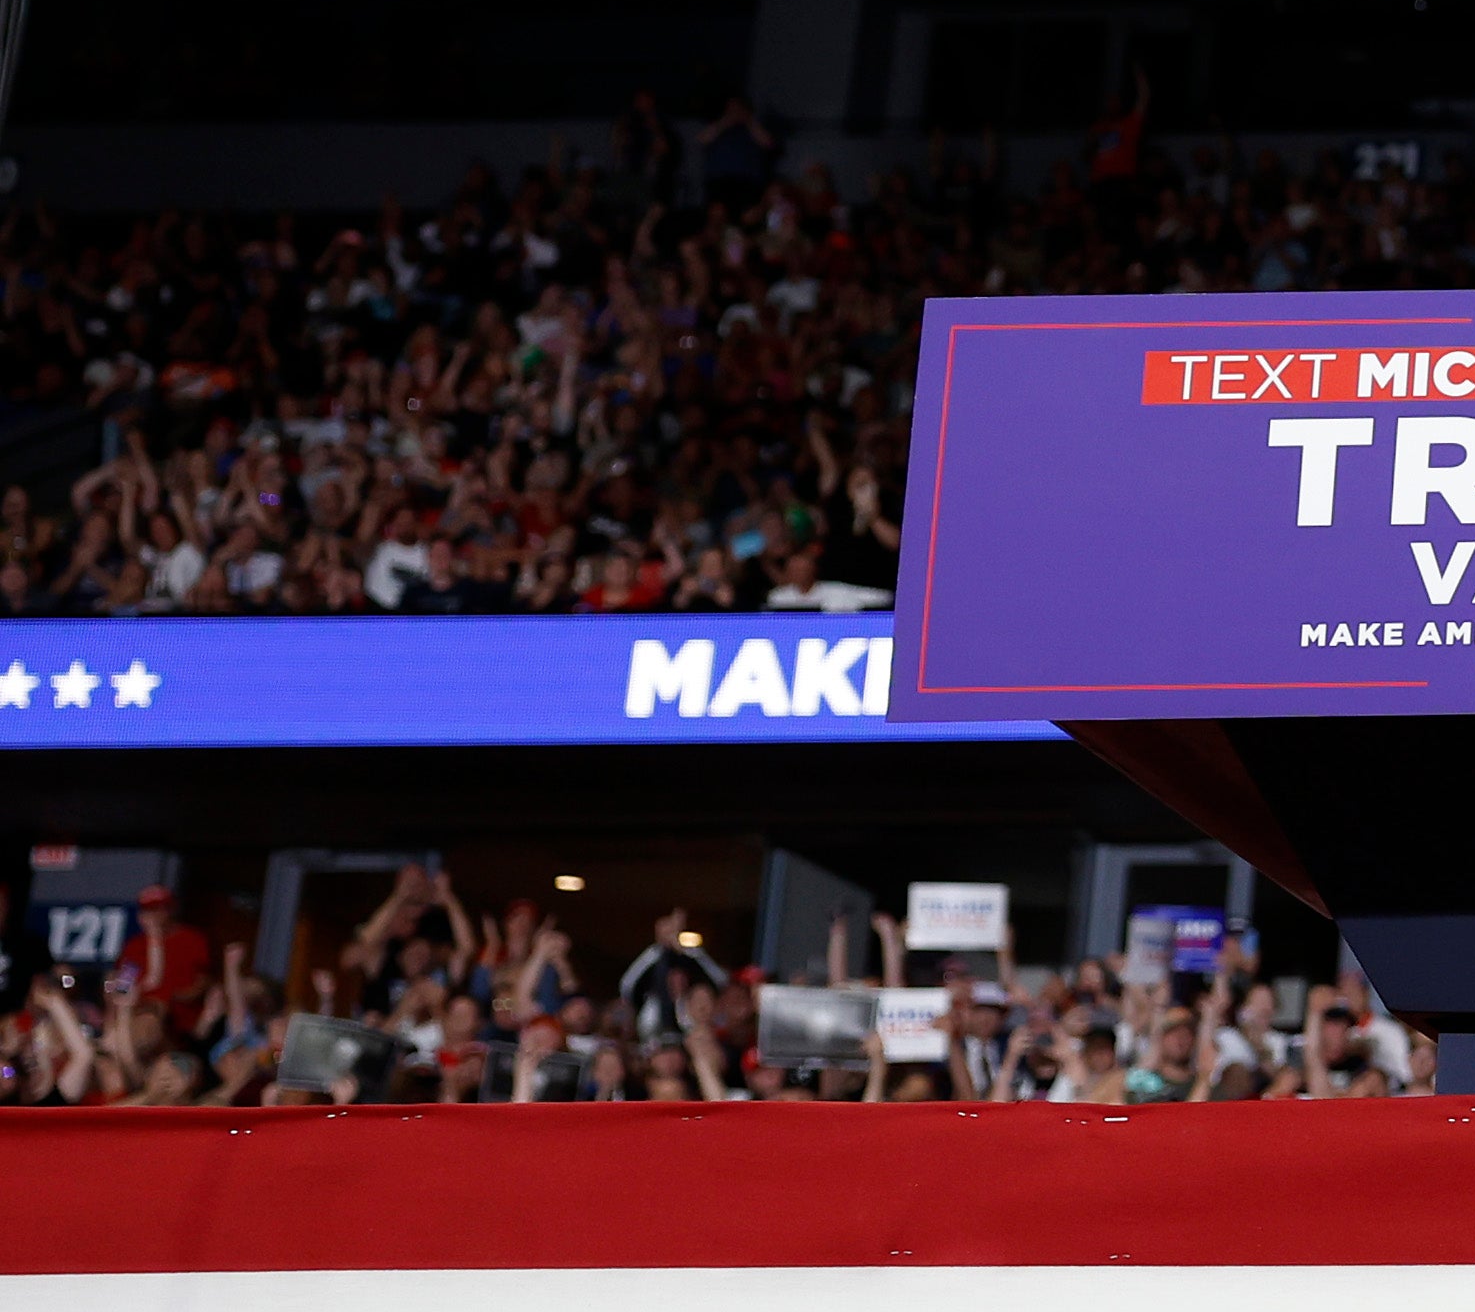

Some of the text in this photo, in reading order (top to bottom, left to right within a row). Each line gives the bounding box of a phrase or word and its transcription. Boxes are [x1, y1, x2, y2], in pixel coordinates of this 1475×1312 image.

[1170, 353, 1337, 400] TEXT
[1300, 622, 1404, 647] MAKE
[48, 905, 126, 962] 121
